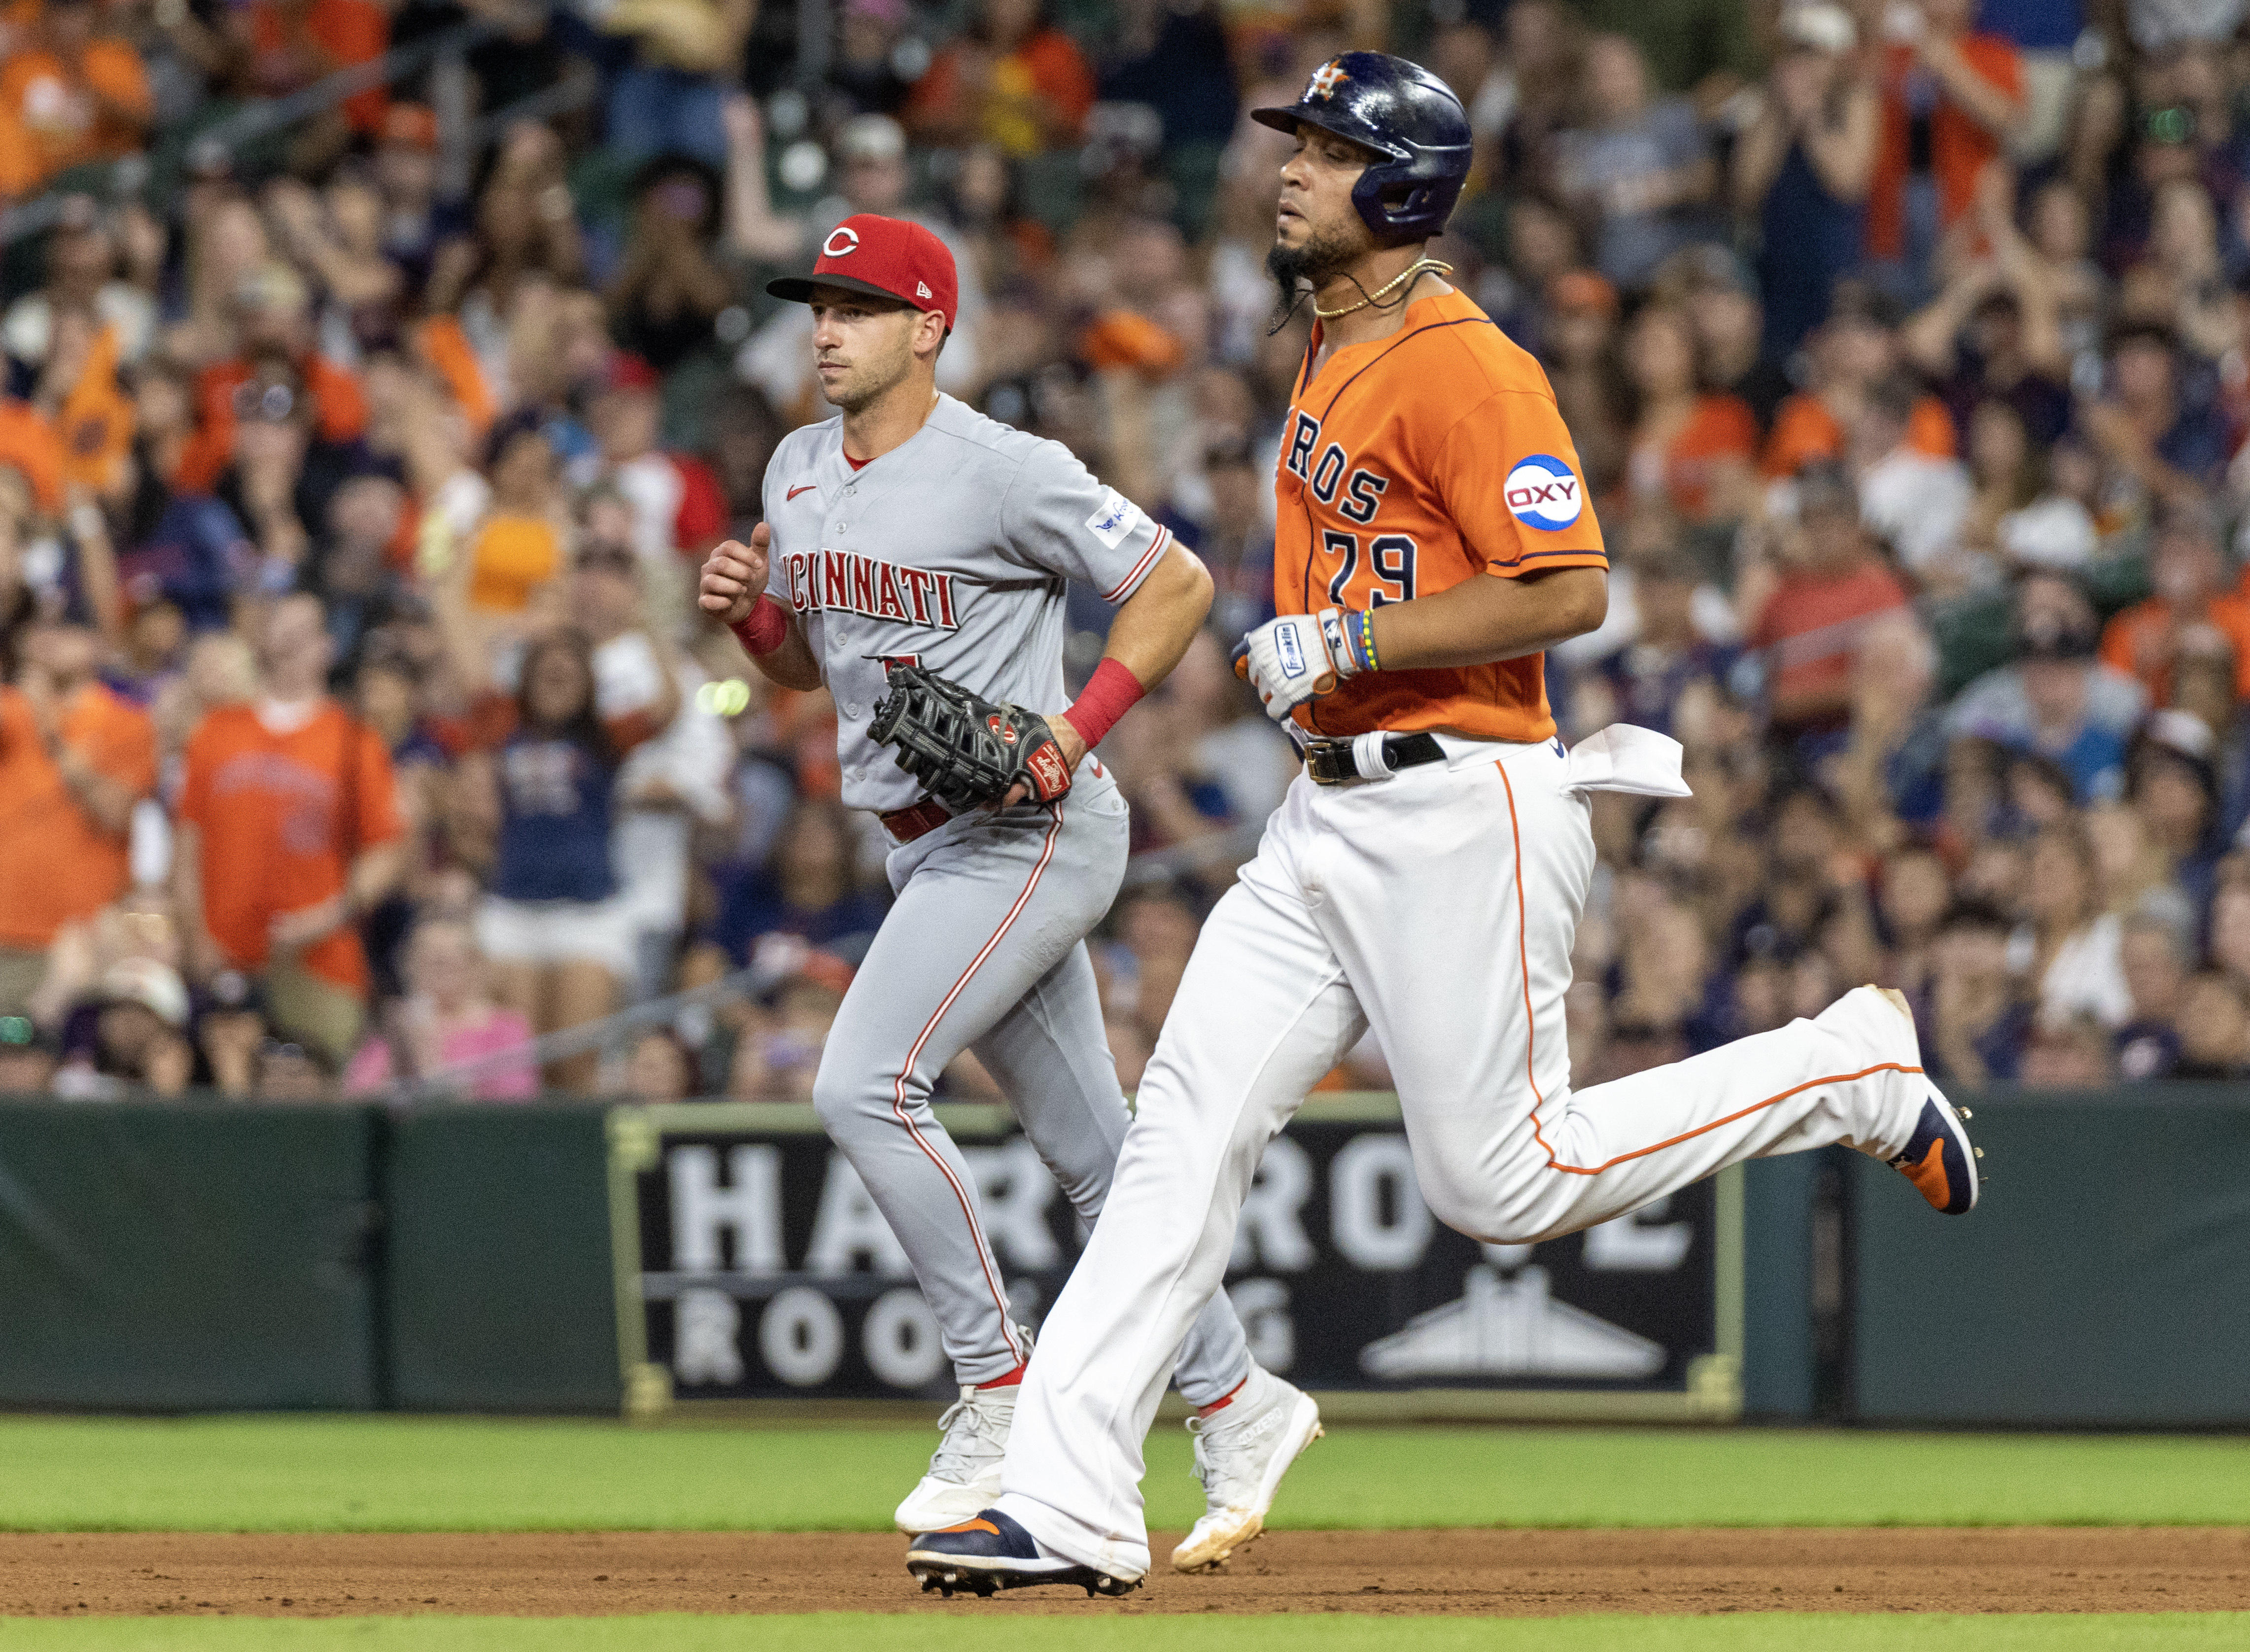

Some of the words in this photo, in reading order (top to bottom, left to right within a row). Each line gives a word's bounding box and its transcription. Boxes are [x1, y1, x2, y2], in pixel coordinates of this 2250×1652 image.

[823, 227, 860, 259] C
[1275, 404, 1390, 525] ROS
[1507, 481, 1577, 508] OXY
[779, 547, 959, 632] CINNATI
[1322, 528, 1418, 610] 79
[1036, 756, 1062, 792] Rawlings
[667, 1132, 1695, 1280] HARRO
[671, 1277, 1296, 1386] ROOG
